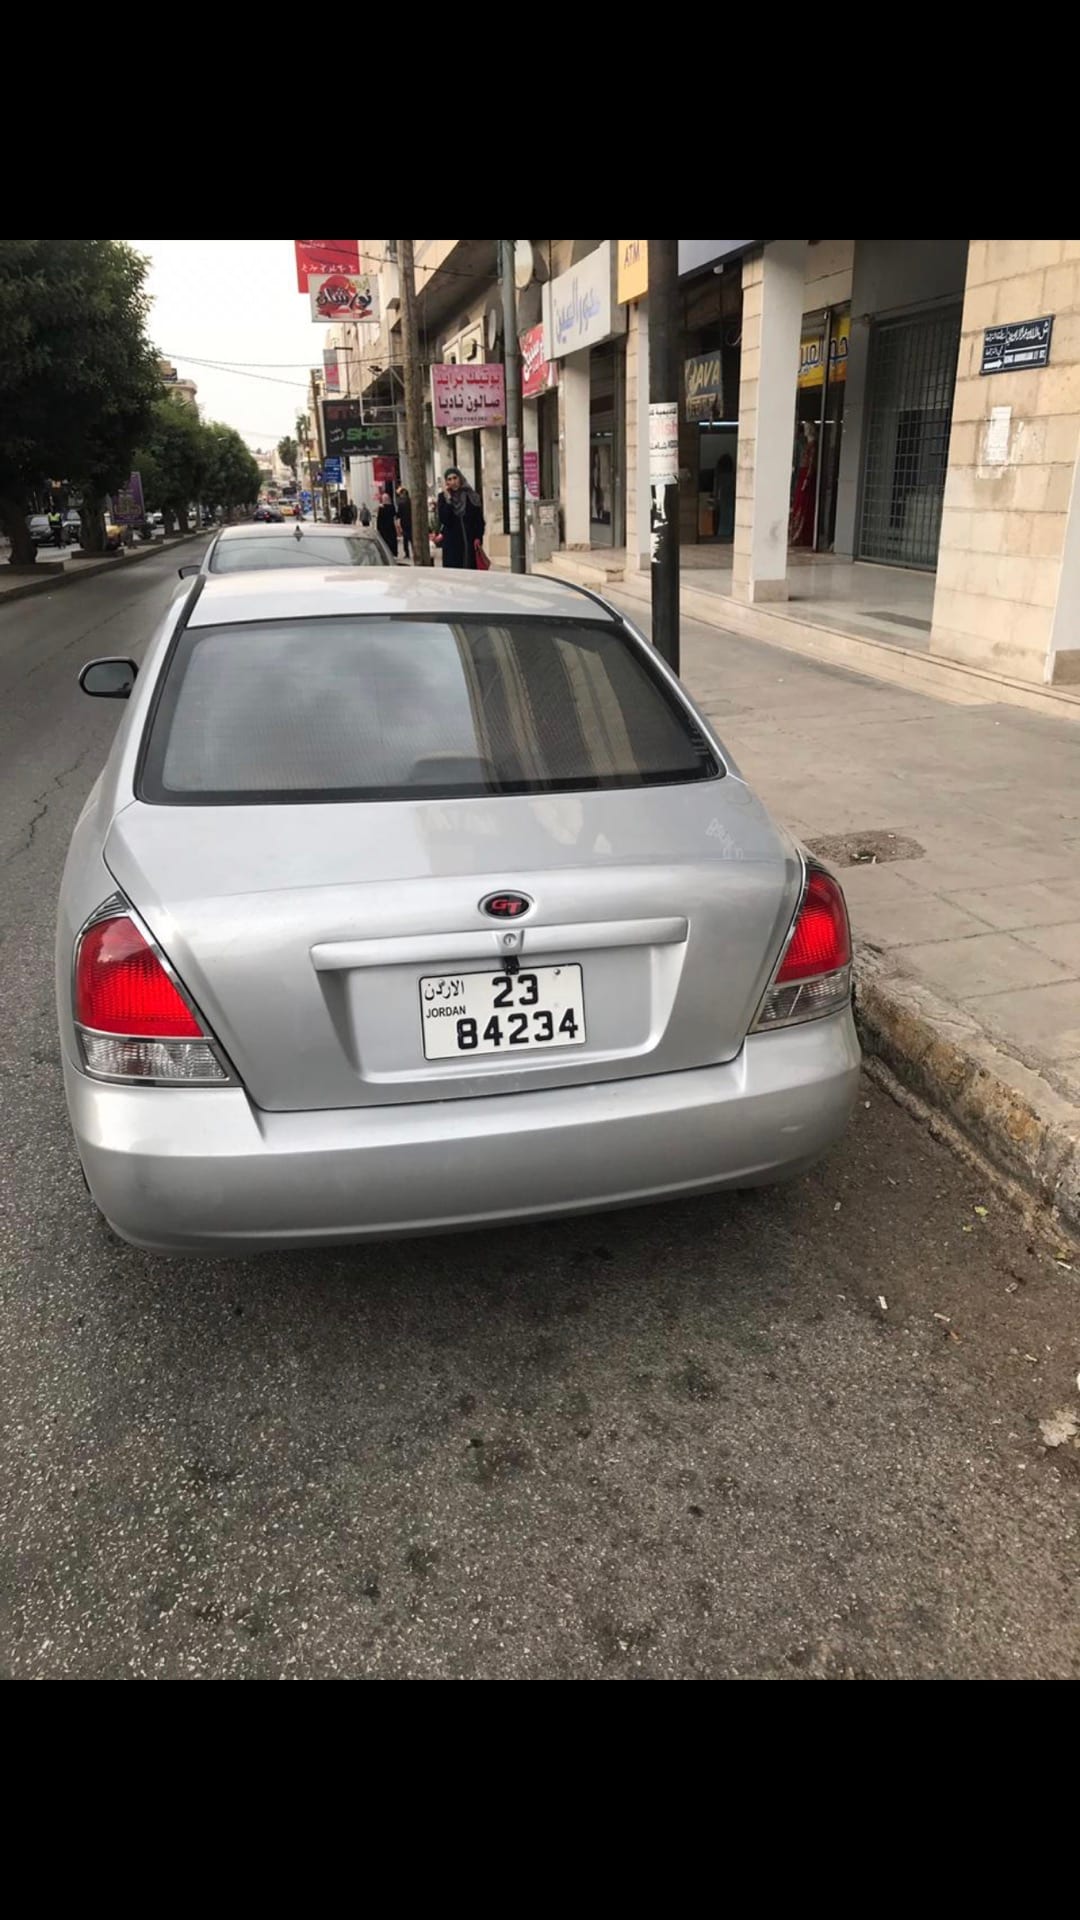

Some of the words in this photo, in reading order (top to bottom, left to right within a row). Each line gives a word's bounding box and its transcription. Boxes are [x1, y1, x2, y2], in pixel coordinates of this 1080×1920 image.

[624, 241, 640, 270] ATM
[437, 372, 464, 390] برايد
[466, 370, 500, 390] بوتيك
[438, 394, 464, 414] ناديا
[466, 394, 500, 412] صالون
[346, 427, 393, 440] SHOP
[491, 899, 522, 915] GT
[492, 974, 539, 1008] 23
[426, 1005, 467, 1019] JORDAN
[456, 1008, 578, 1050] 84234
